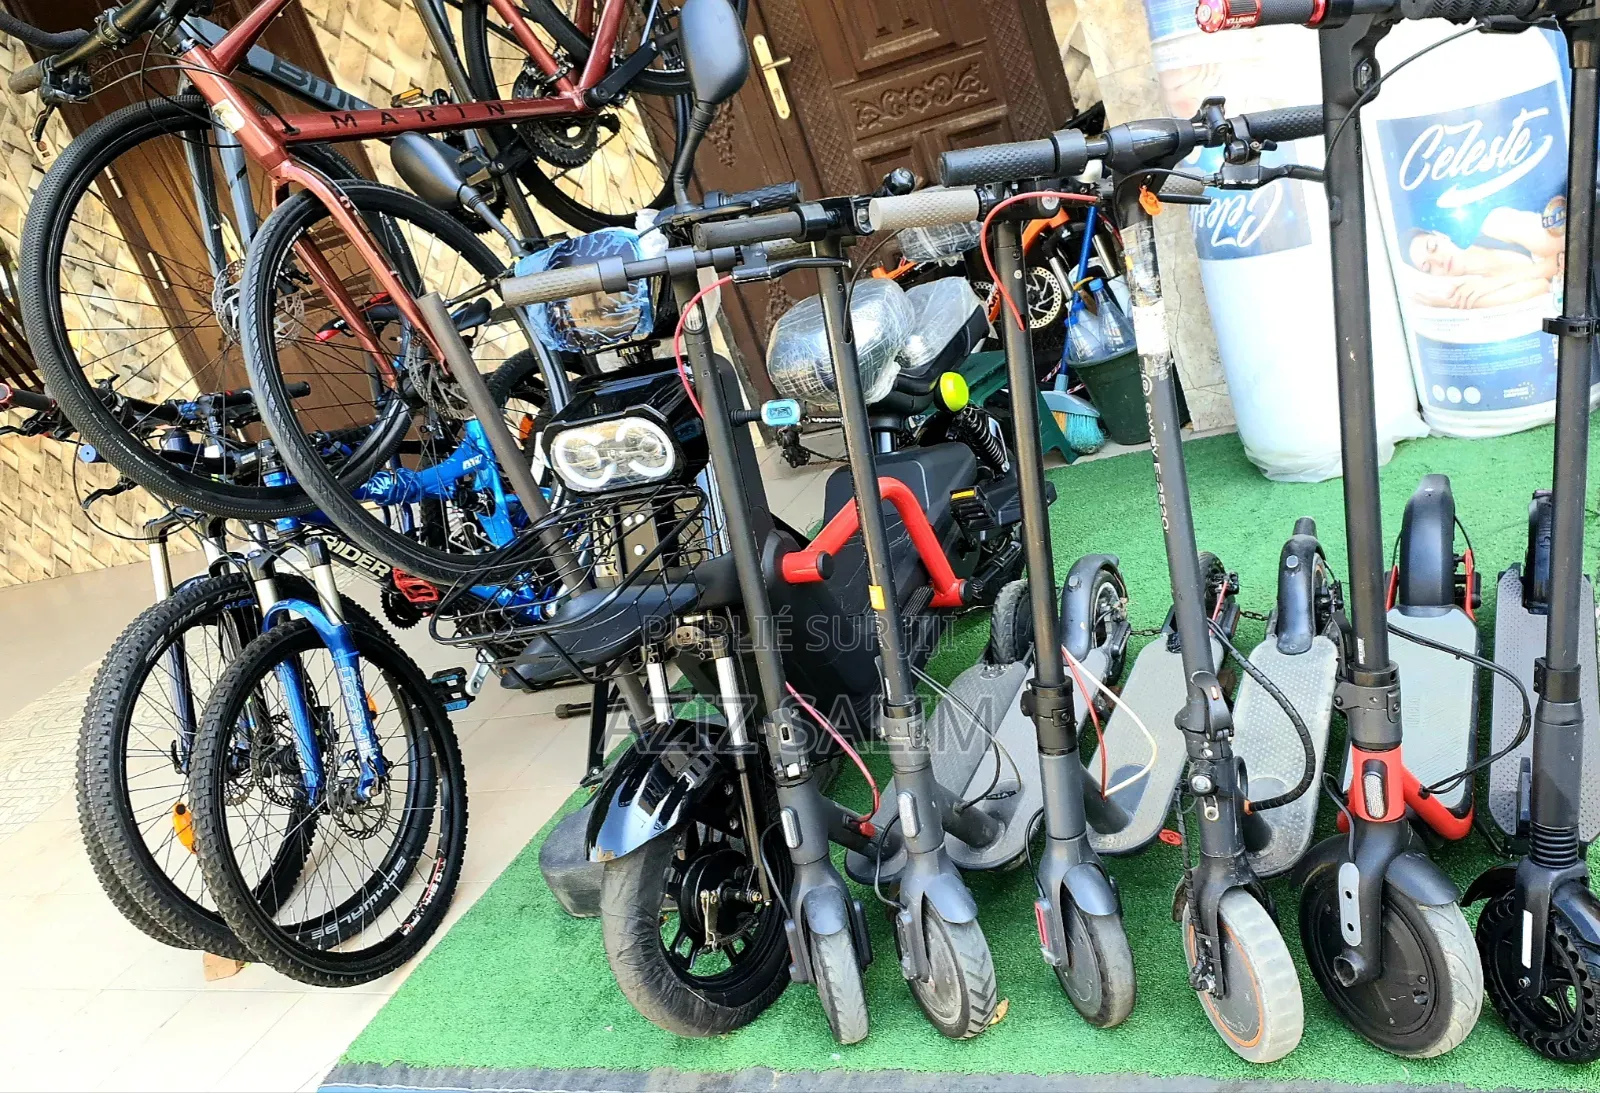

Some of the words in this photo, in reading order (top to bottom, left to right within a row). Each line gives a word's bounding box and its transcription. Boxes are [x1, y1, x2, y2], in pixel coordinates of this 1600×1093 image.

[330, 102, 506, 130] MARIN
[1400, 108, 1551, 192] Celeste
[1190, 181, 1284, 248] Celest
[311, 856, 407, 940] SCHWALBE
